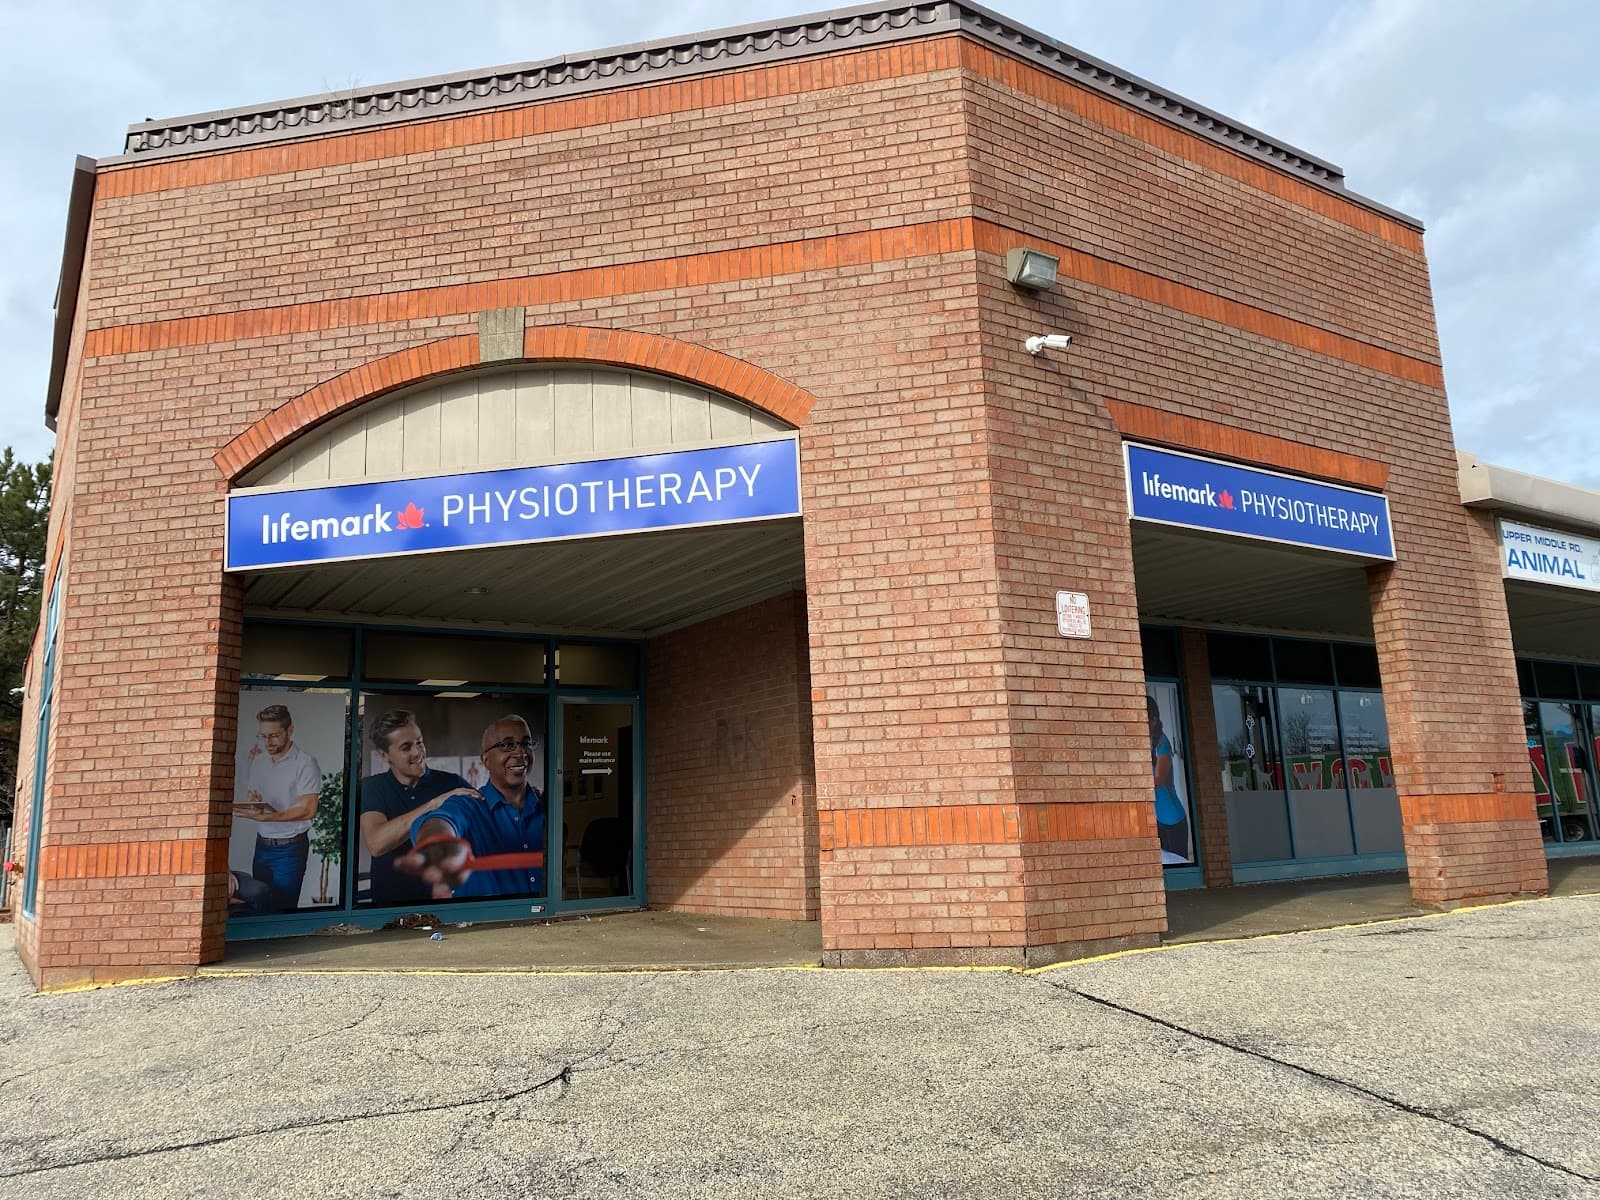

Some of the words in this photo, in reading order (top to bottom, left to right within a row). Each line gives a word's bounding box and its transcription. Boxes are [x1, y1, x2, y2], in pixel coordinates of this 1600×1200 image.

[262, 503, 393, 545] lifemark
[442, 463, 763, 527] PHYSIOTHERAPY
[1142, 471, 1218, 508] lifemark
[1240, 489, 1379, 536] PHYSIOTHERAPY
[1503, 529, 1532, 543] UPPER
[1534, 535, 1567, 550] MIDDLE
[1508, 548, 1585, 579] ANIMAL
[579, 735, 609, 744] lifemark
